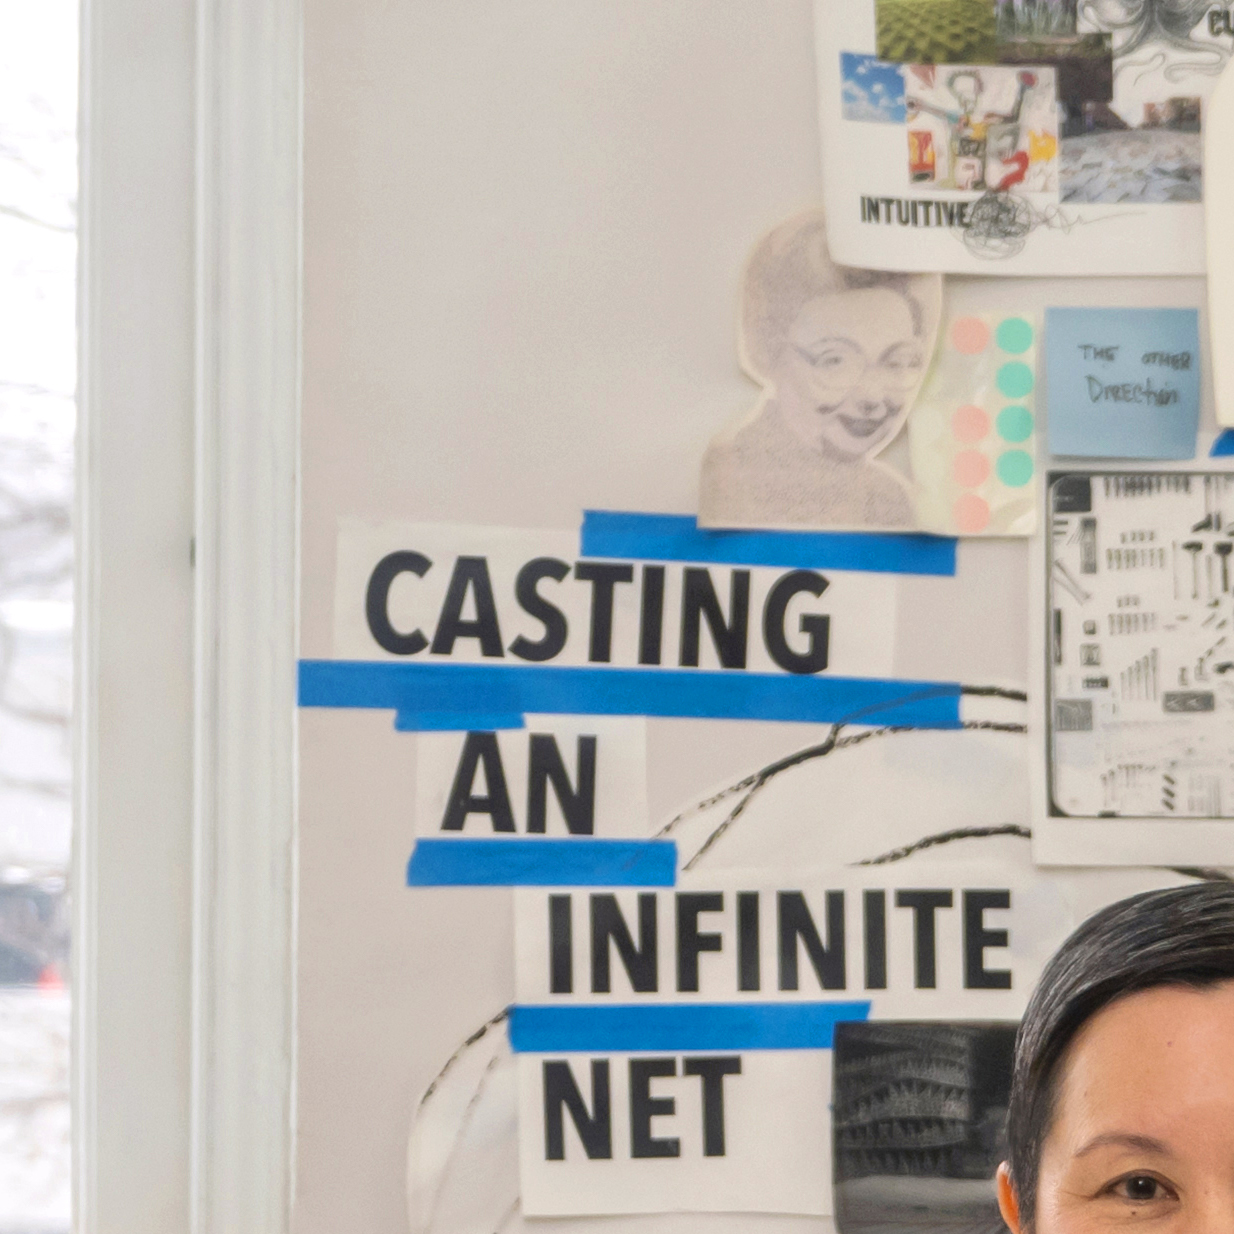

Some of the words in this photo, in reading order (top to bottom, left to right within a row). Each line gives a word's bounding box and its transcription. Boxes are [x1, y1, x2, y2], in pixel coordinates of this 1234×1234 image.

[860, 196, 971, 229] INTUITIVE
[1077, 343, 1120, 361] THE
[364, 549, 831, 676] CASTING
[440, 730, 599, 837] AN
[548, 889, 1013, 994] INFINITE
[542, 1054, 743, 1161] NET
